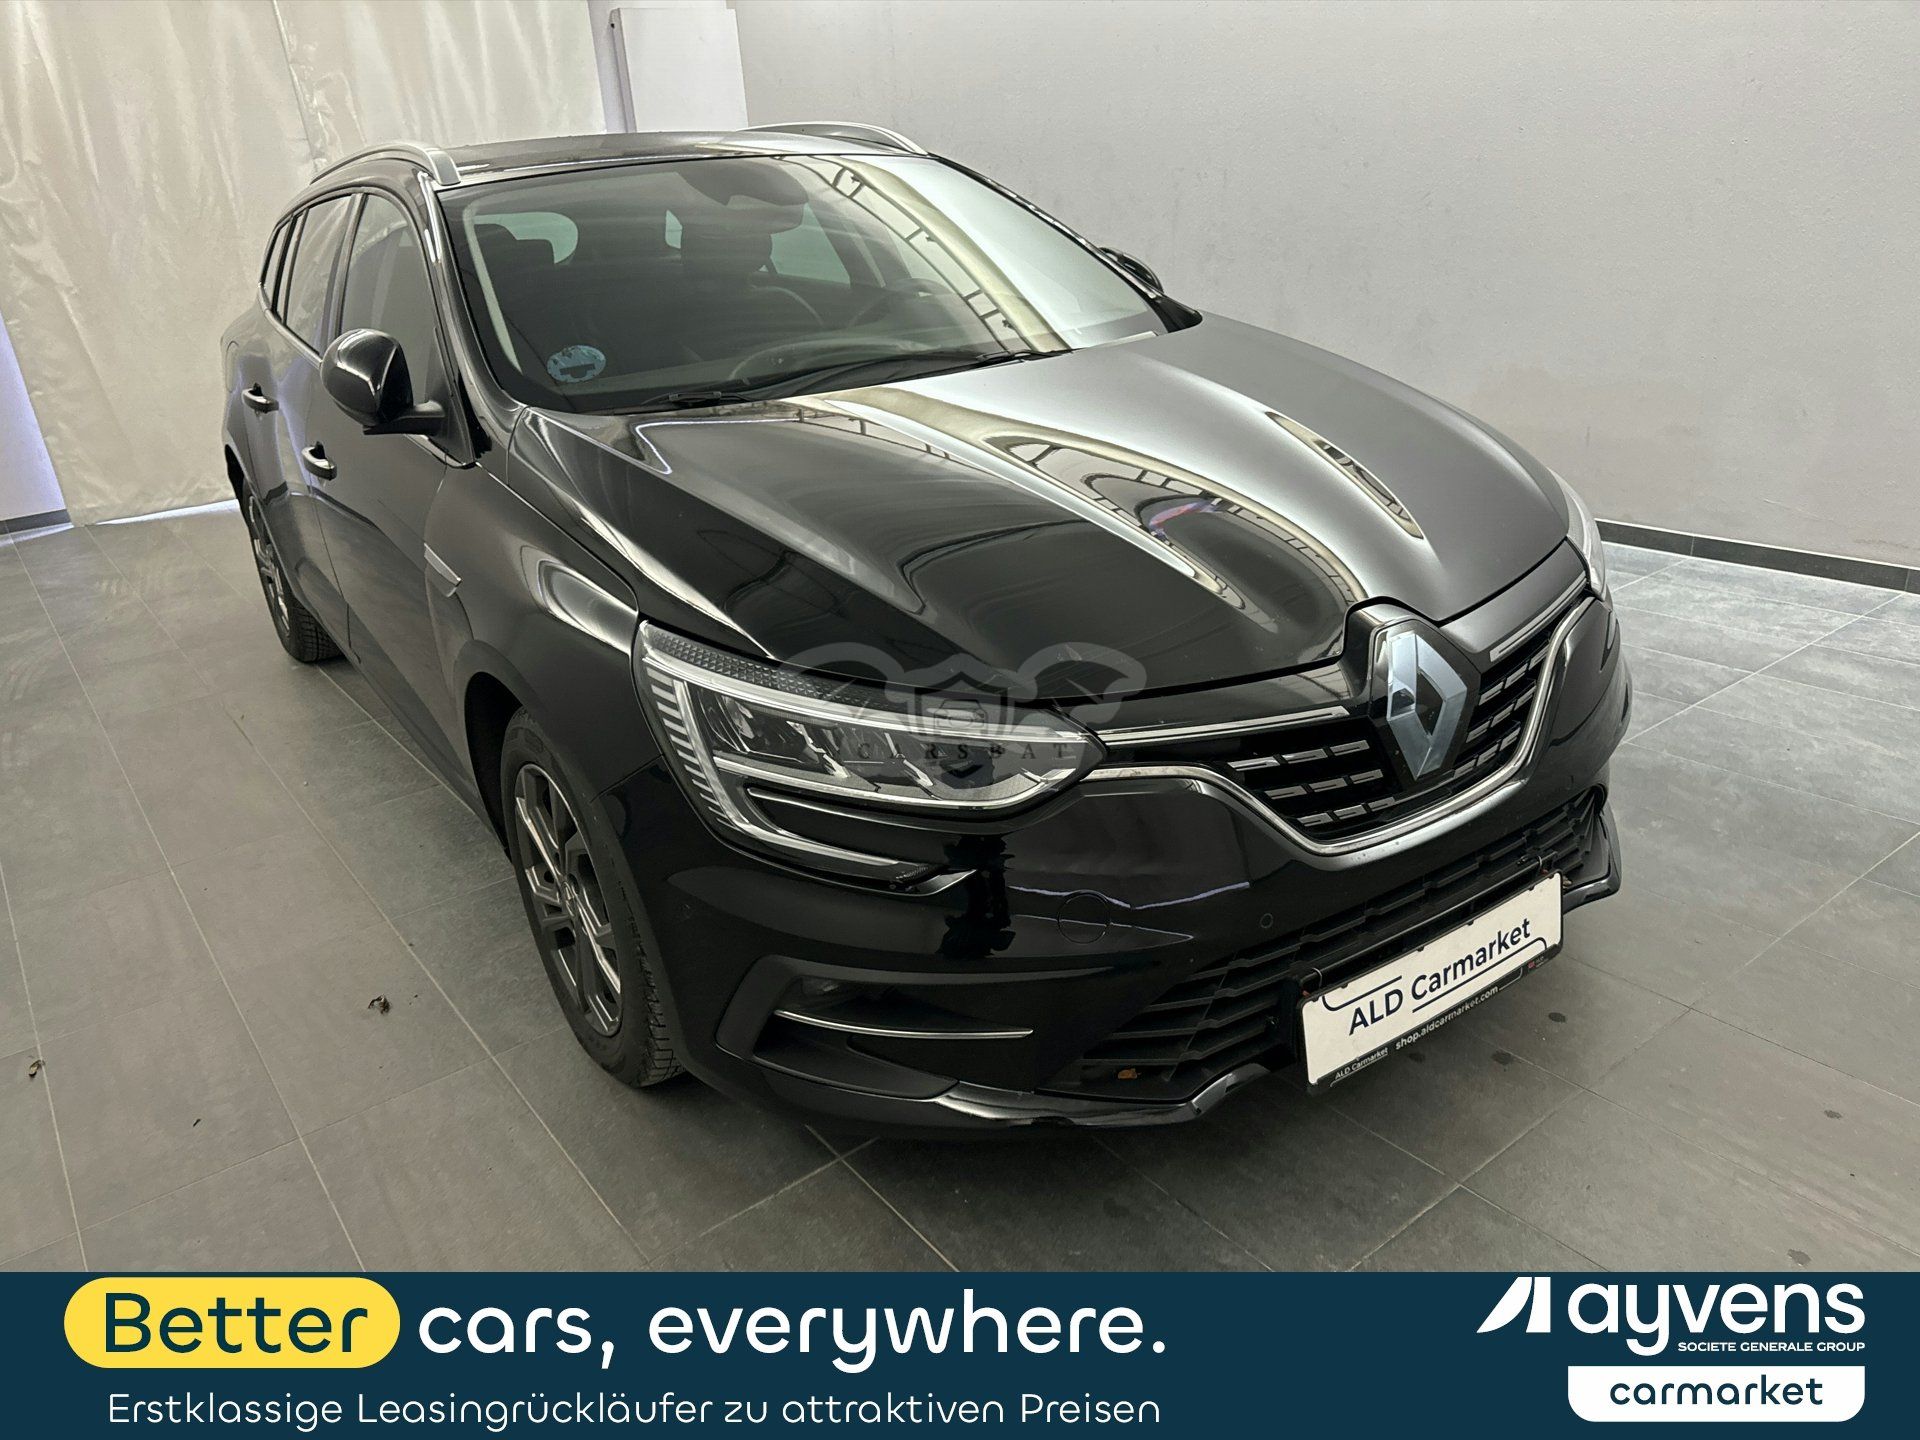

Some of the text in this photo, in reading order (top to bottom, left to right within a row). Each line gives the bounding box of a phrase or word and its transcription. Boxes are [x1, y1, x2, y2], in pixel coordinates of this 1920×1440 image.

[1349, 918, 1531, 1036] ALD Carmarket
[1395, 984, 1499, 1050] shop.aldcarmarket.com
[1351, 1047, 1389, 1071] Carmarket
